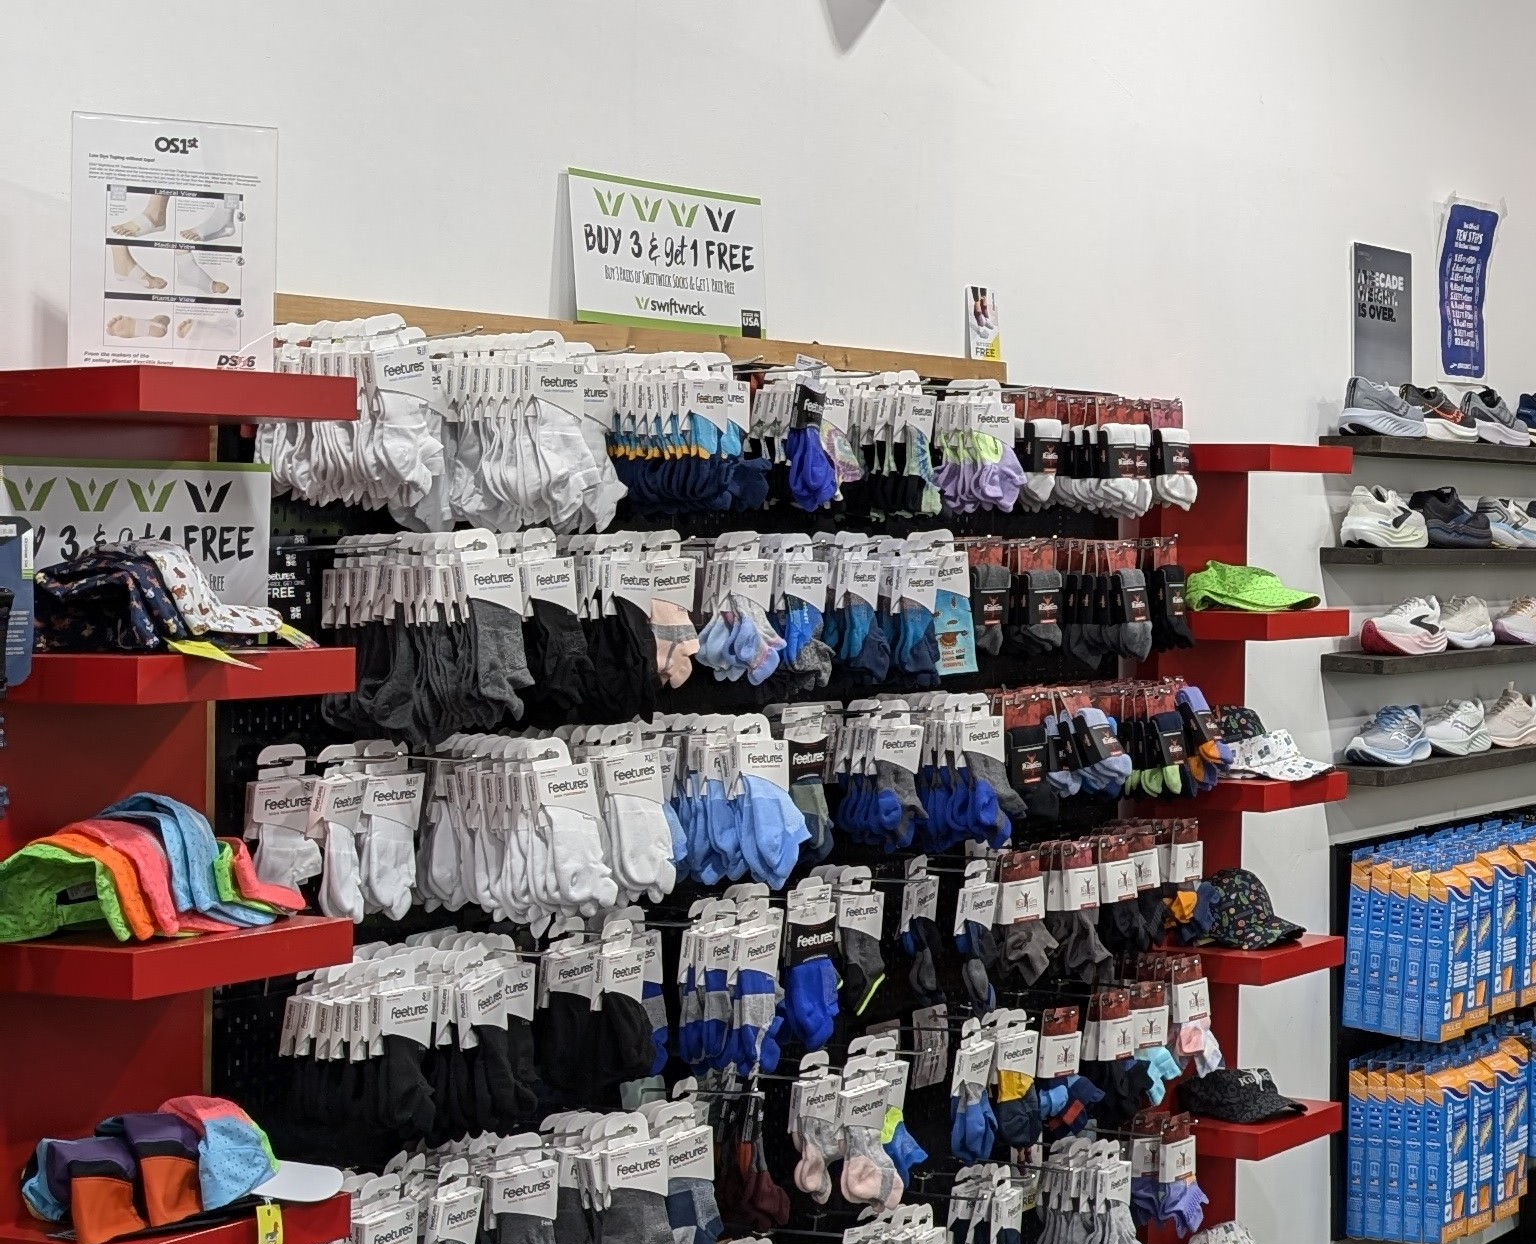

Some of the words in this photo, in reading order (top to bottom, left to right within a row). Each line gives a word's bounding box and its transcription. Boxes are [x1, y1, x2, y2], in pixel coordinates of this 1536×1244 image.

[583, 223, 622, 255] BUY
[629, 230, 643, 258] 3
[648, 232, 660, 266] &
[664, 234, 688, 267] get
[690, 238, 698, 267] 1
[705, 240, 755, 273] FREE
[651, 297, 706, 316] swiftwick
[1358, 303, 1366, 318] IS
[1368, 304, 1397, 322] OVER.
[742, 316, 760, 327] USA
[975, 347, 995, 358] FREE
[383, 361, 424, 376] feetures
[540, 376, 578, 388] feetures
[583, 388, 608, 398] tures
[727, 394, 745, 403] ures
[977, 414, 1010, 425] feetures
[59, 525, 80, 560] 3
[183, 525, 255, 563] FREE
[737, 572, 768, 584] feetures
[938, 565, 963, 577] etures
[474, 573, 514, 586] feetures
[536, 573, 570, 586] feetures
[620, 573, 650, 586] feetures
[653, 574, 691, 588] feetures
[791, 573, 822, 585] feetures
[908, 577, 934, 588] feetures
[969, 729, 1000, 742] feetures
[882, 739, 917, 750] feetures
[748, 752, 783, 764] feetures
[792, 751, 825, 765] feetures
[614, 765, 656, 781] feetures
[548, 778, 589, 794] feetures
[373, 788, 417, 802] feetures
[264, 796, 312, 811] feetures
[846, 905, 878, 918] feetures
[797, 931, 833, 948] feetures
[713, 944, 730, 957] feet
[747, 941, 777, 958] feetures
[558, 962, 594, 980] feetures
[612, 964, 641, 979] feetures
[505, 980, 528, 995] tures
[391, 1003, 429, 1019] feetures
[1003, 1047, 1034, 1060] feetures
[806, 1093, 836, 1106] feetures
[851, 1098, 883, 1115] feetures
[668, 1143, 709, 1166] feetures
[616, 1158, 661, 1176] feetures
[502, 1180, 551, 1200] feetures
[447, 1207, 478, 1226] feetures
